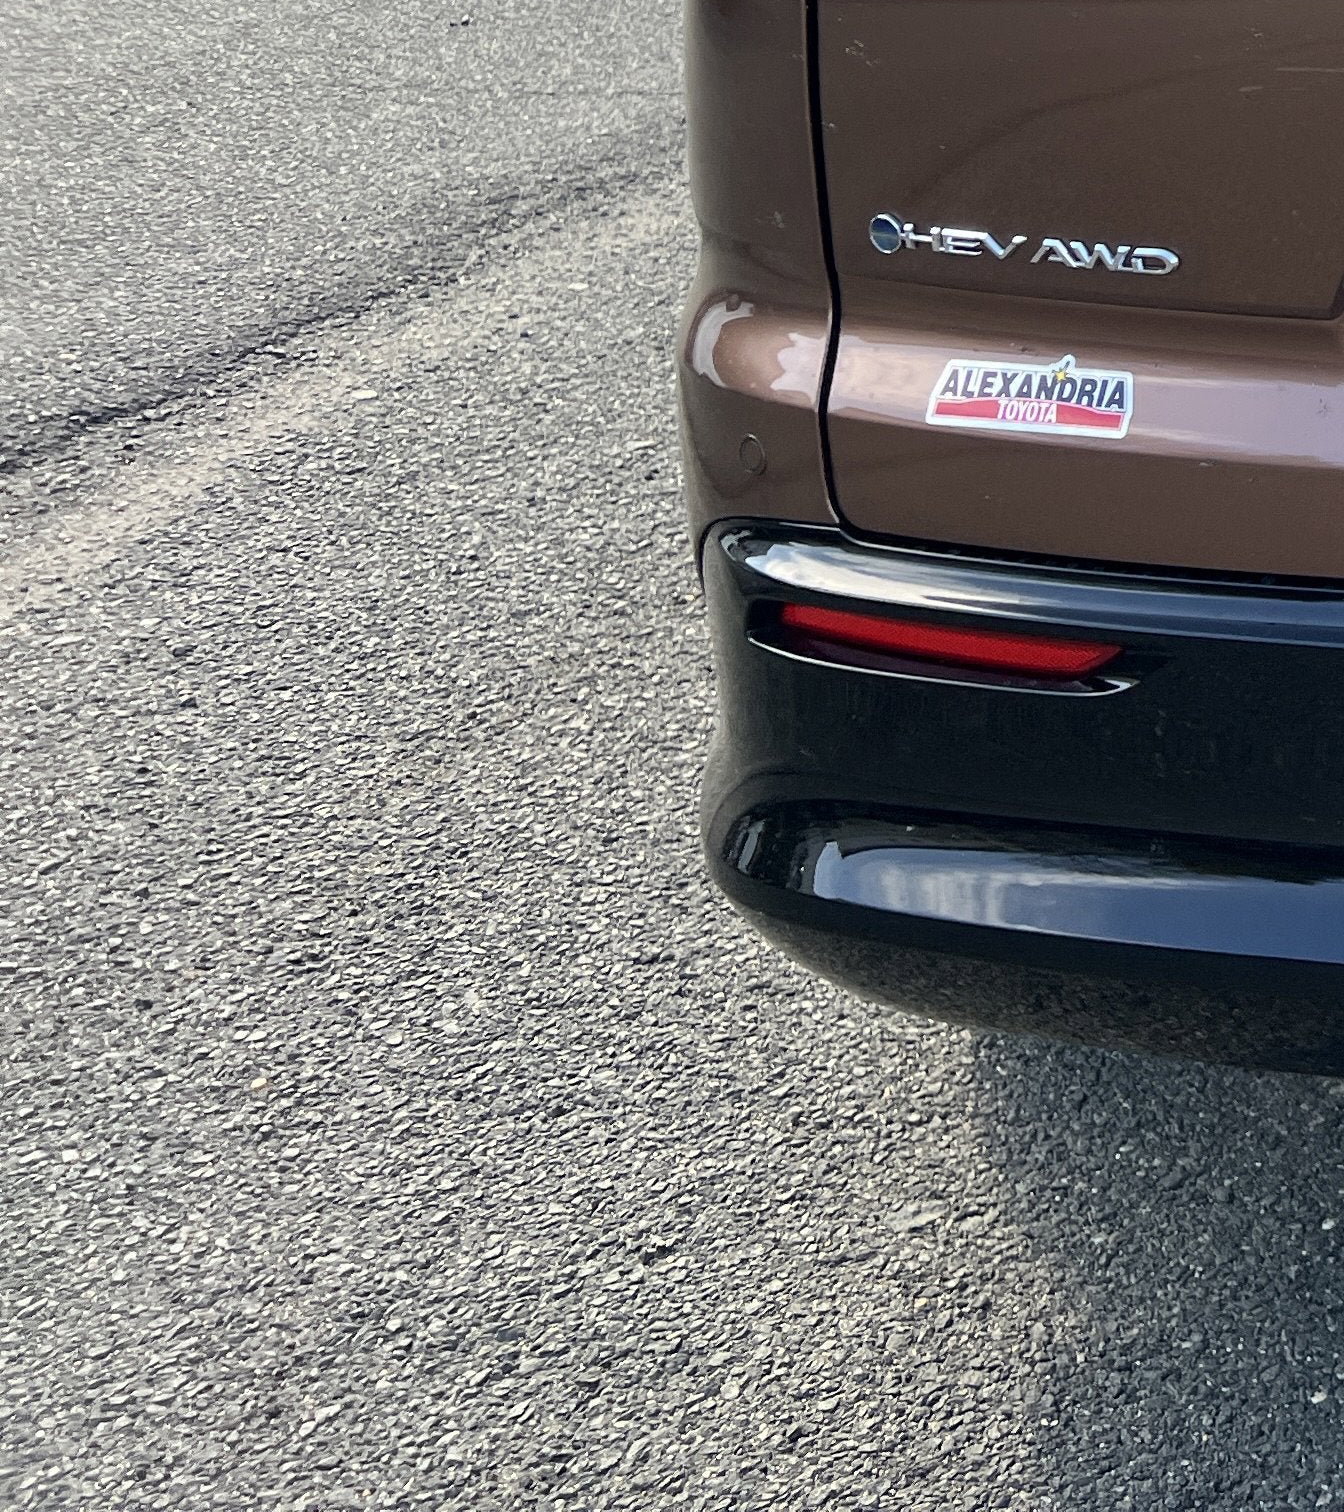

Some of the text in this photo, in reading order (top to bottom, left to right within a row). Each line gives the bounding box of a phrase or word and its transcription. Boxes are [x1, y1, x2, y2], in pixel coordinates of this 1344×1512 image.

[900, 221, 1181, 276] HEV AWD
[938, 367, 1126, 411] ALEXANDRIA
[995, 399, 1058, 424] TOYOTA
